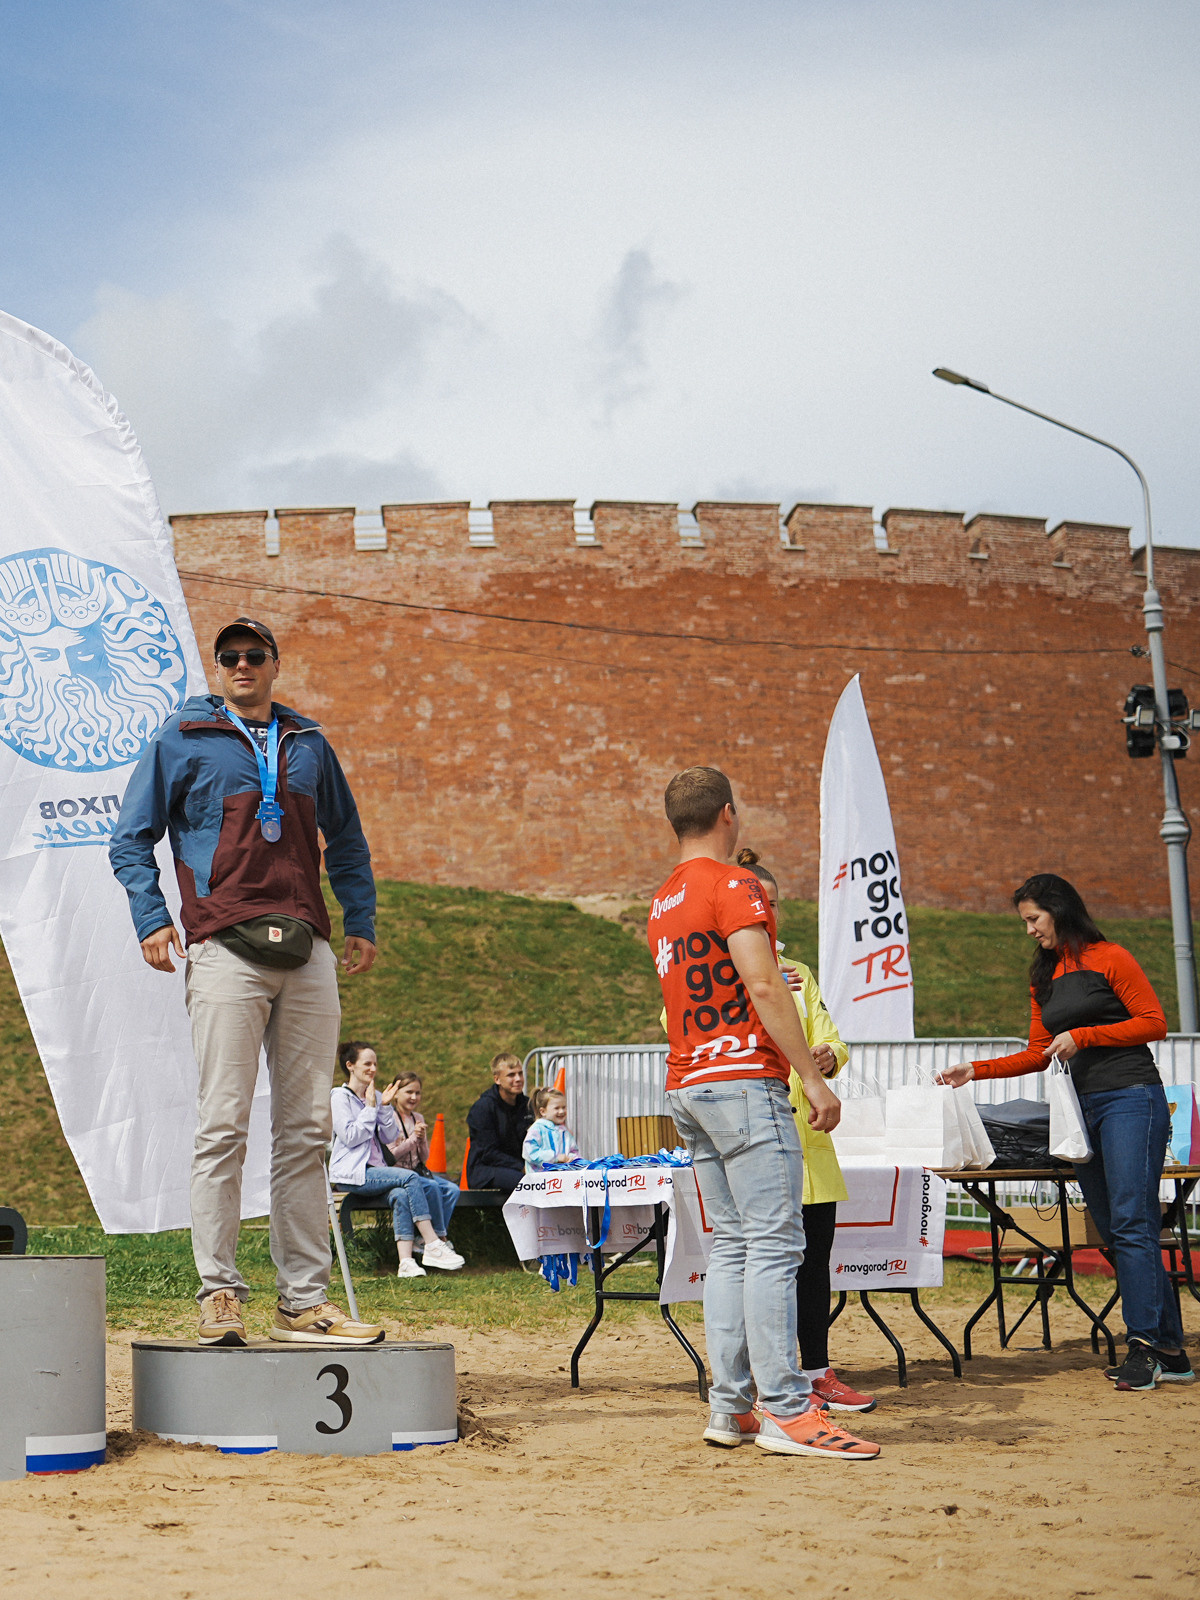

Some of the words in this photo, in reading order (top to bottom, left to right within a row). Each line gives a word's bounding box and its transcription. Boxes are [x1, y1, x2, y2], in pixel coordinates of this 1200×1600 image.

[683, 983, 749, 1036] rod
[835, 1259, 907, 1276] #novgorodTRI
[315, 1363, 353, 1435] 3
